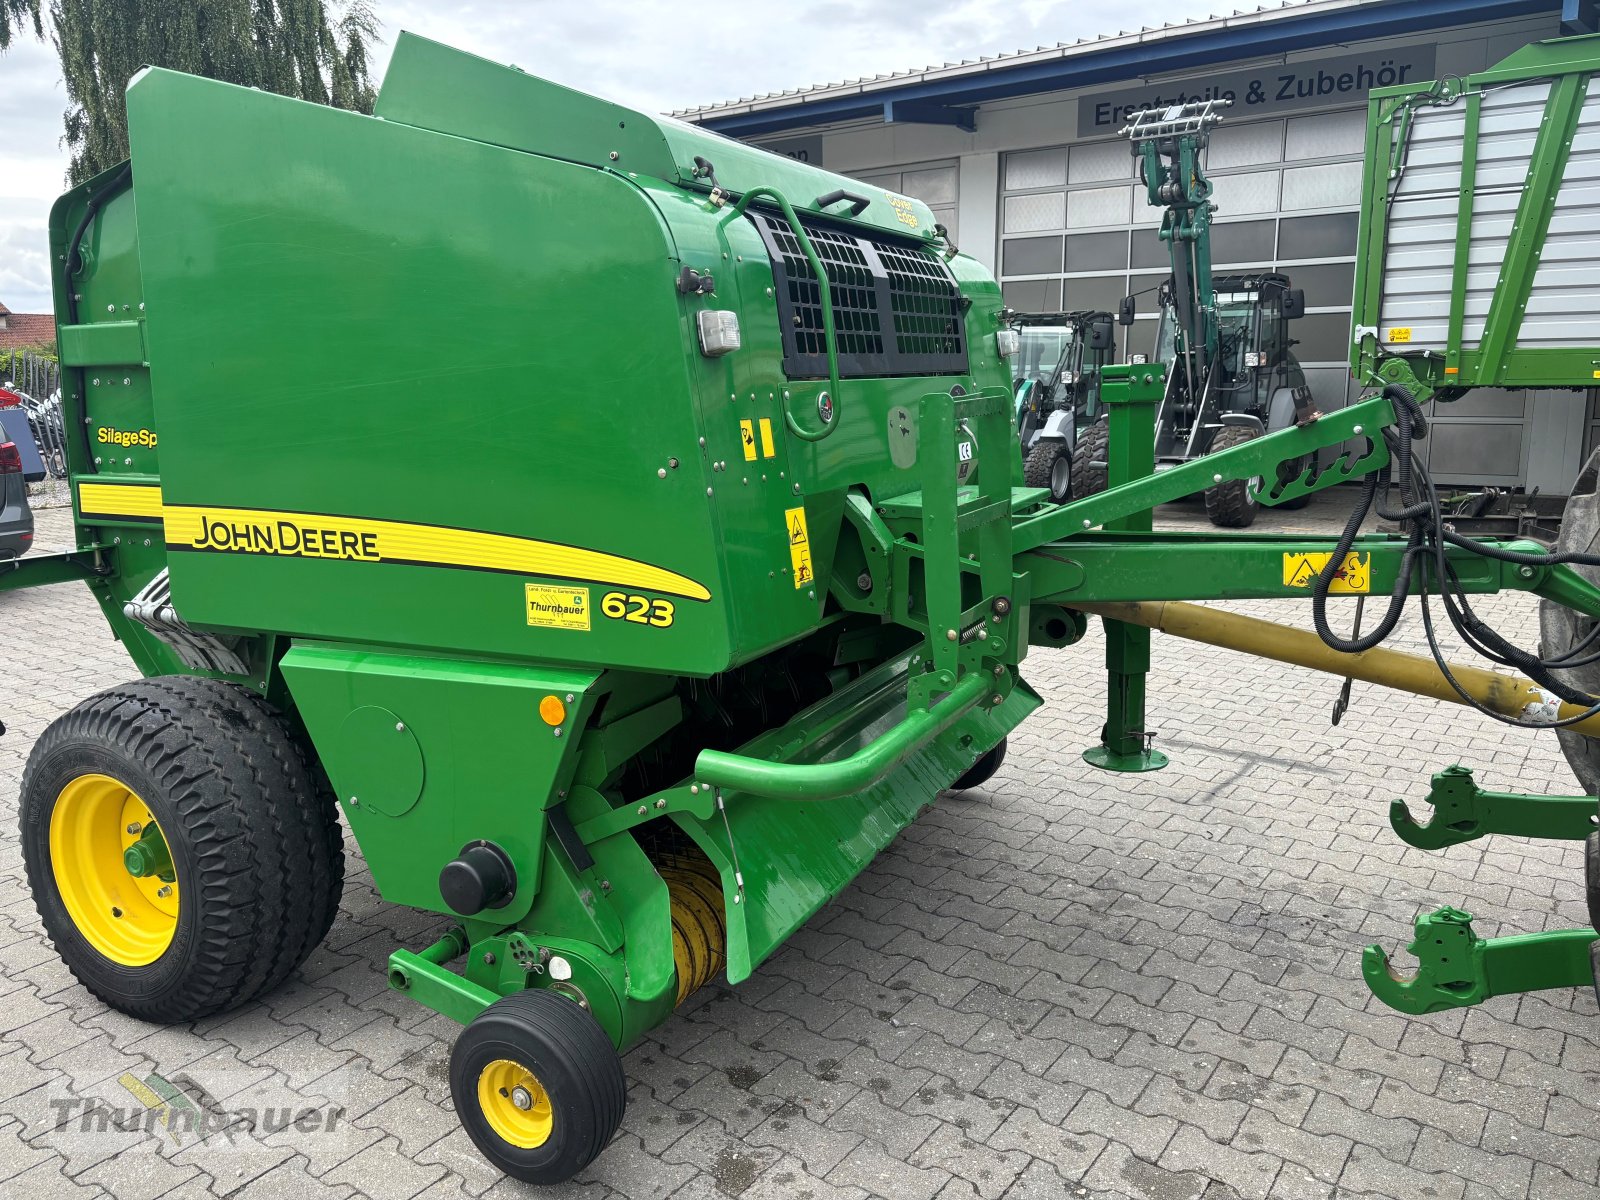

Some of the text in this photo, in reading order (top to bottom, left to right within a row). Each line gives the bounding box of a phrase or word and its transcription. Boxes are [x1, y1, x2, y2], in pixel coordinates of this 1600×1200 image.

[1246, 79, 1266, 105] &
[1276, 60, 1412, 101] Zubehör
[195, 516, 380, 557] JOHN DEERE
[530, 601, 584, 615] Thurnbauer
[600, 591, 675, 628] 623
